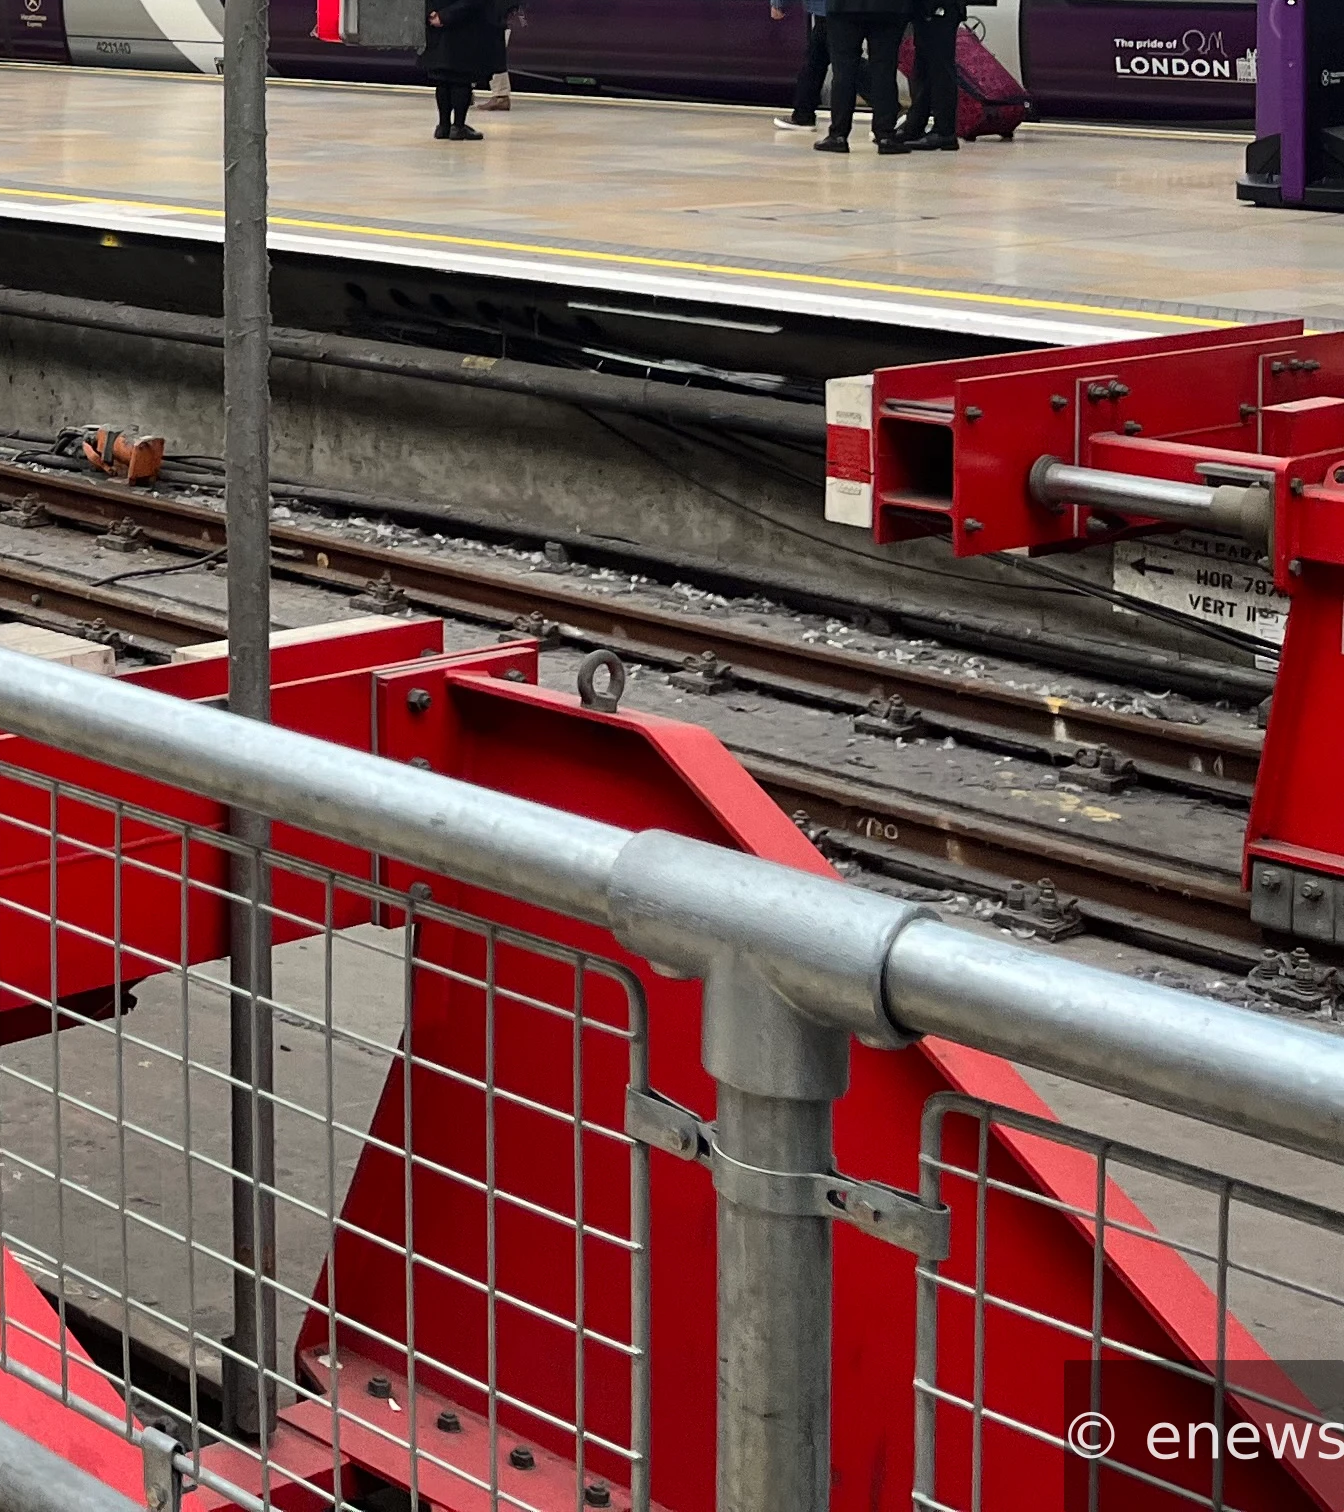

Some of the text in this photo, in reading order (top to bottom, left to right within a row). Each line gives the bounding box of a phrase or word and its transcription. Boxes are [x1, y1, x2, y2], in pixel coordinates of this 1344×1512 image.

[1114, 38, 1178, 49] The pride of
[1115, 56, 1230, 78] LONDON
[1197, 569, 1233, 589] HOR
[1188, 593, 1237, 618] VERT
